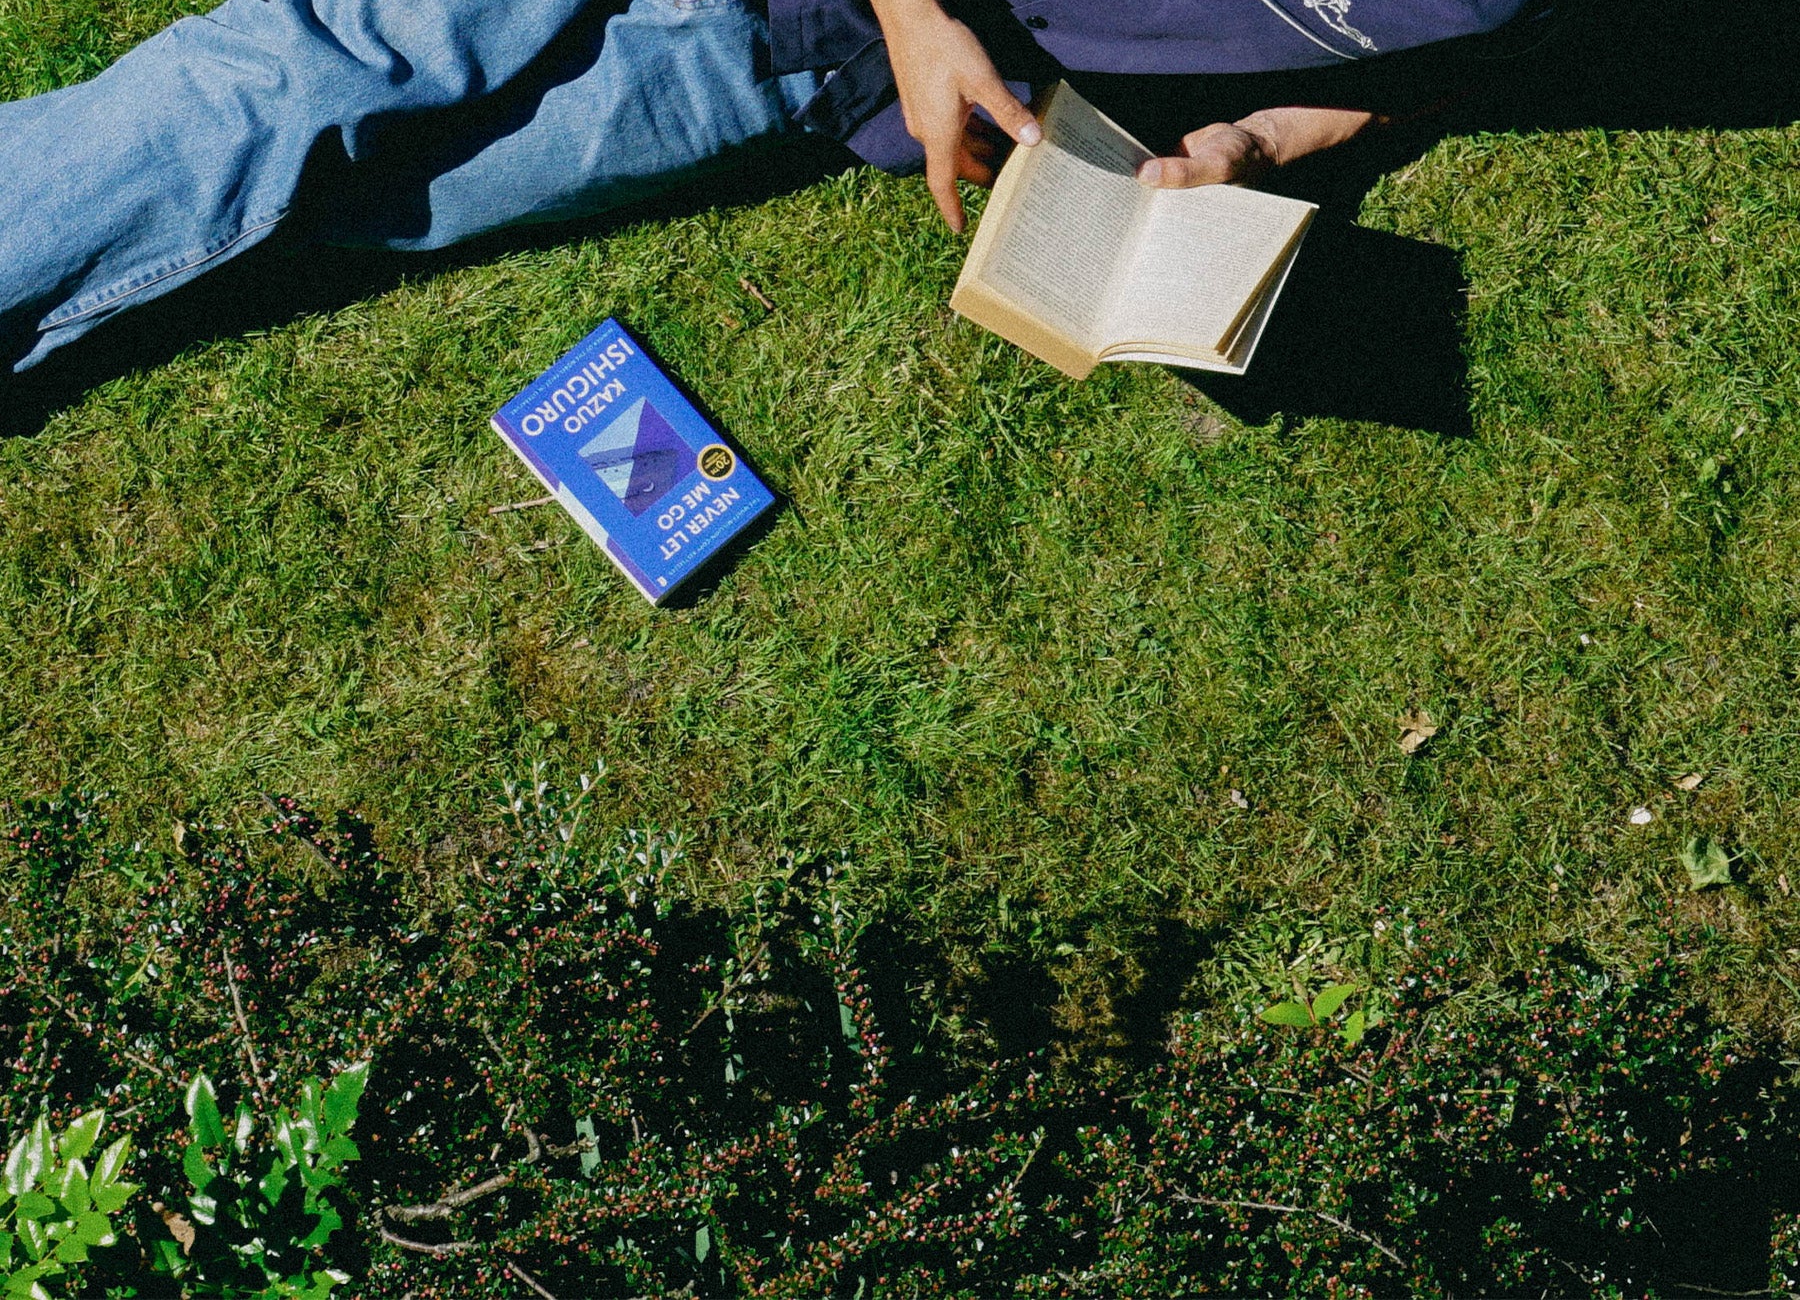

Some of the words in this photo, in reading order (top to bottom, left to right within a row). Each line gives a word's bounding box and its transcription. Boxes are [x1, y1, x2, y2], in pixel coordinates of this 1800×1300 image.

[521, 338, 634, 435] ISHIGURO
[564, 378, 627, 432] KAZUO
[681, 481, 710, 509] ME
[685, 487, 739, 534] NEVER
[657, 504, 684, 529] GO
[660, 530, 688, 559] LET
